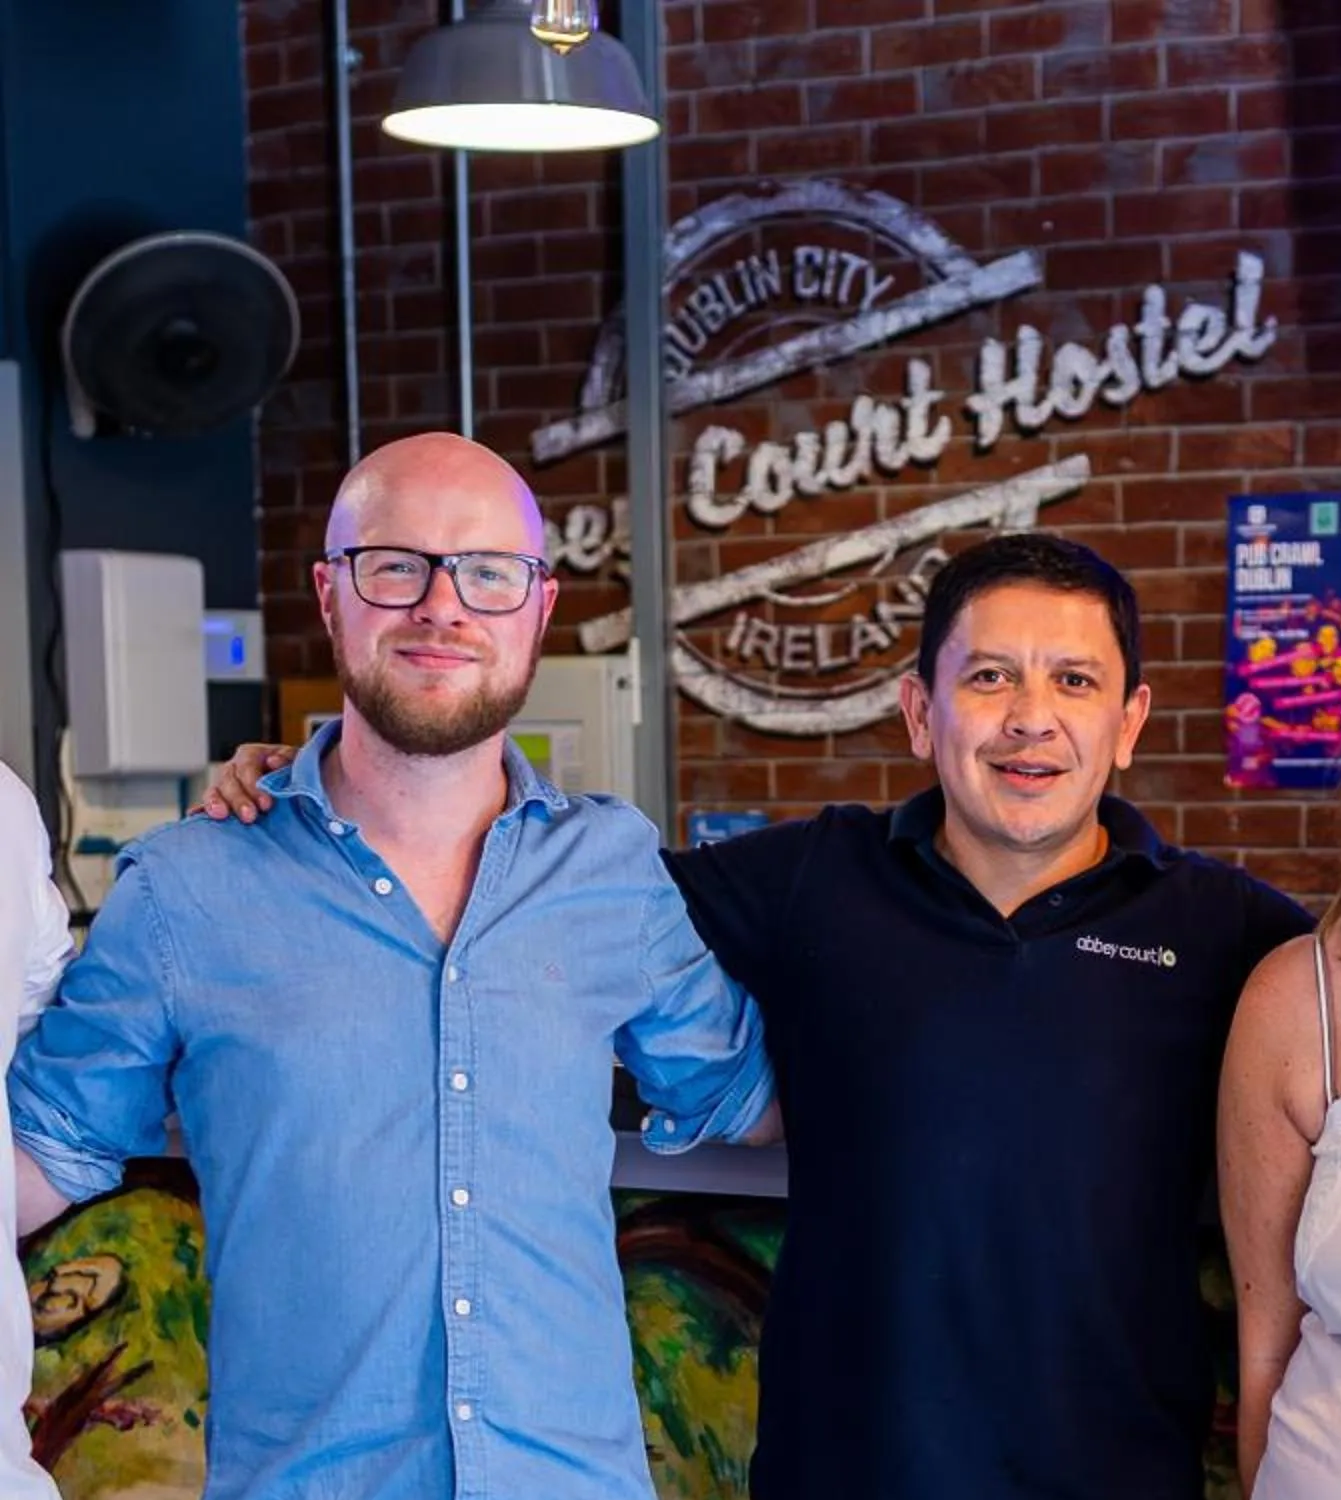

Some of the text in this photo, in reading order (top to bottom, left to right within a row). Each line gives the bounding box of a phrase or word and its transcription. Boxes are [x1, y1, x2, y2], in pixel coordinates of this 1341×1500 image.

[793, 245, 897, 313] CITY
[688, 250, 1278, 528] Court Hostel
[1234, 540, 1325, 567] PUB CRAWL
[1234, 566, 1293, 593] DUBLIN
